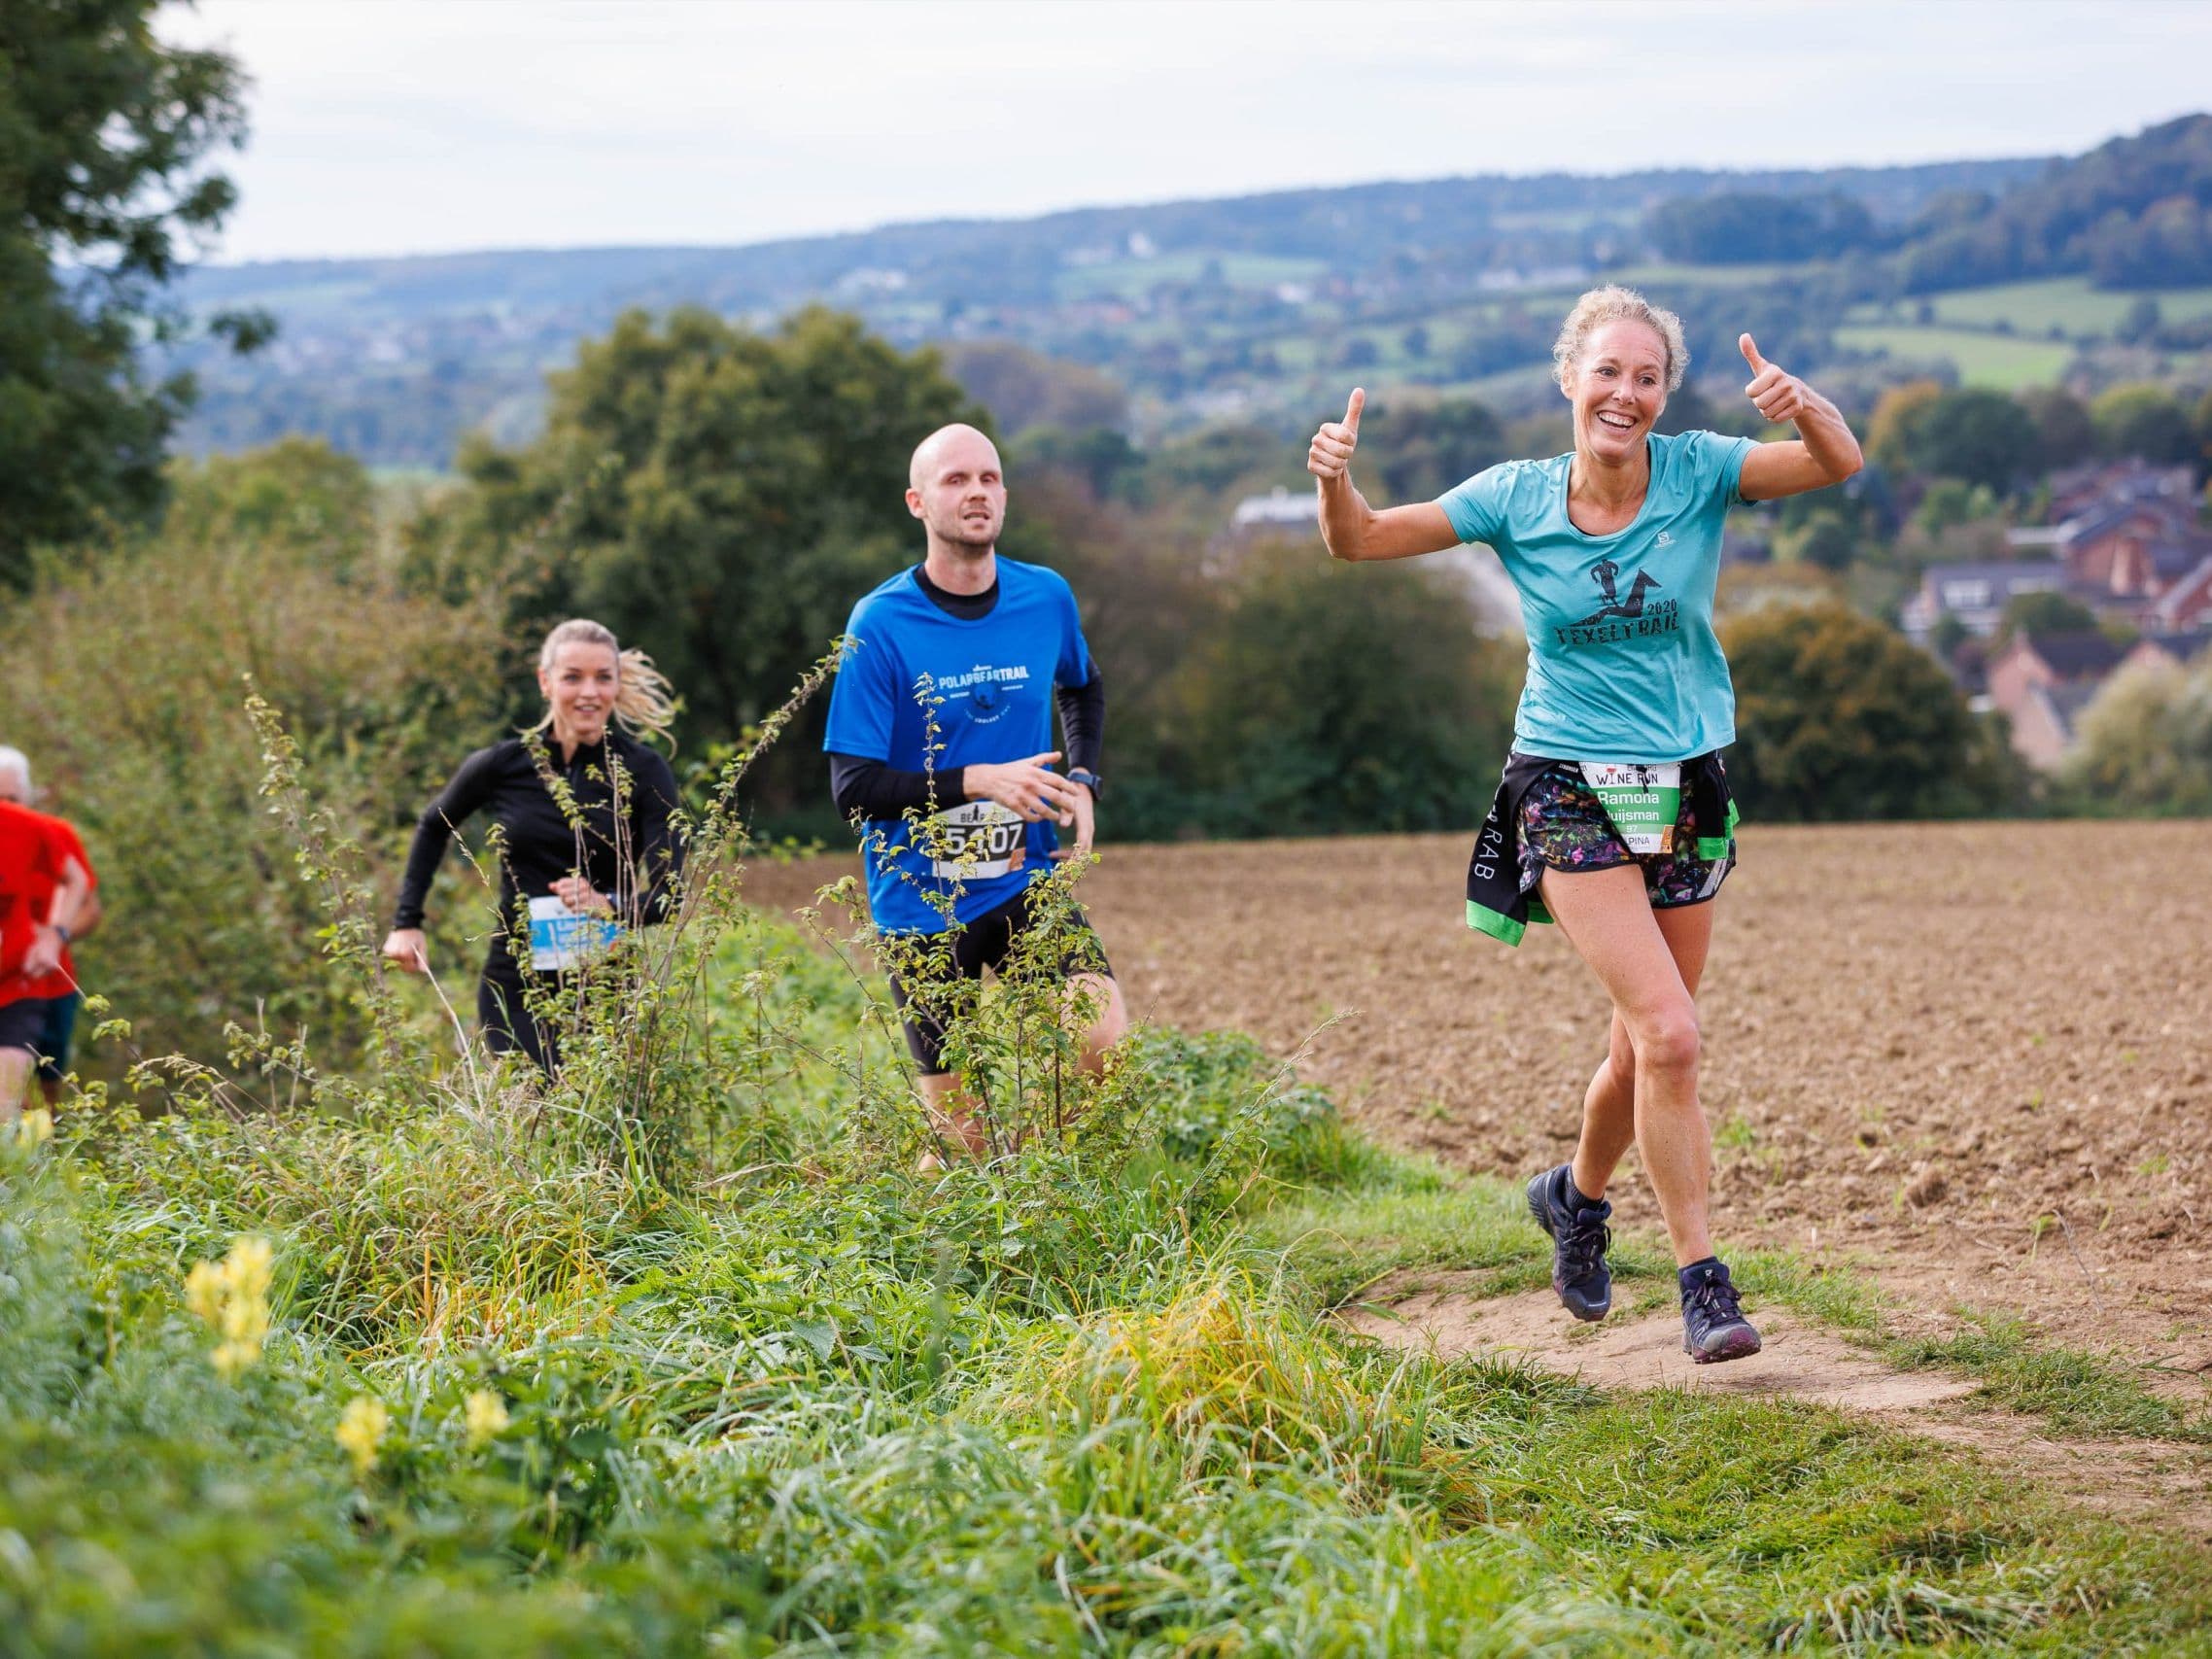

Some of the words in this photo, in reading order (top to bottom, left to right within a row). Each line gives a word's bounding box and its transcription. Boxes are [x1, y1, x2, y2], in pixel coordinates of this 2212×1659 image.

[1647, 599, 1677, 616] 2020
[1596, 768, 1633, 785] WINE
[1637, 773, 1659, 785] RUN
[1597, 791, 1660, 805] Ramona
